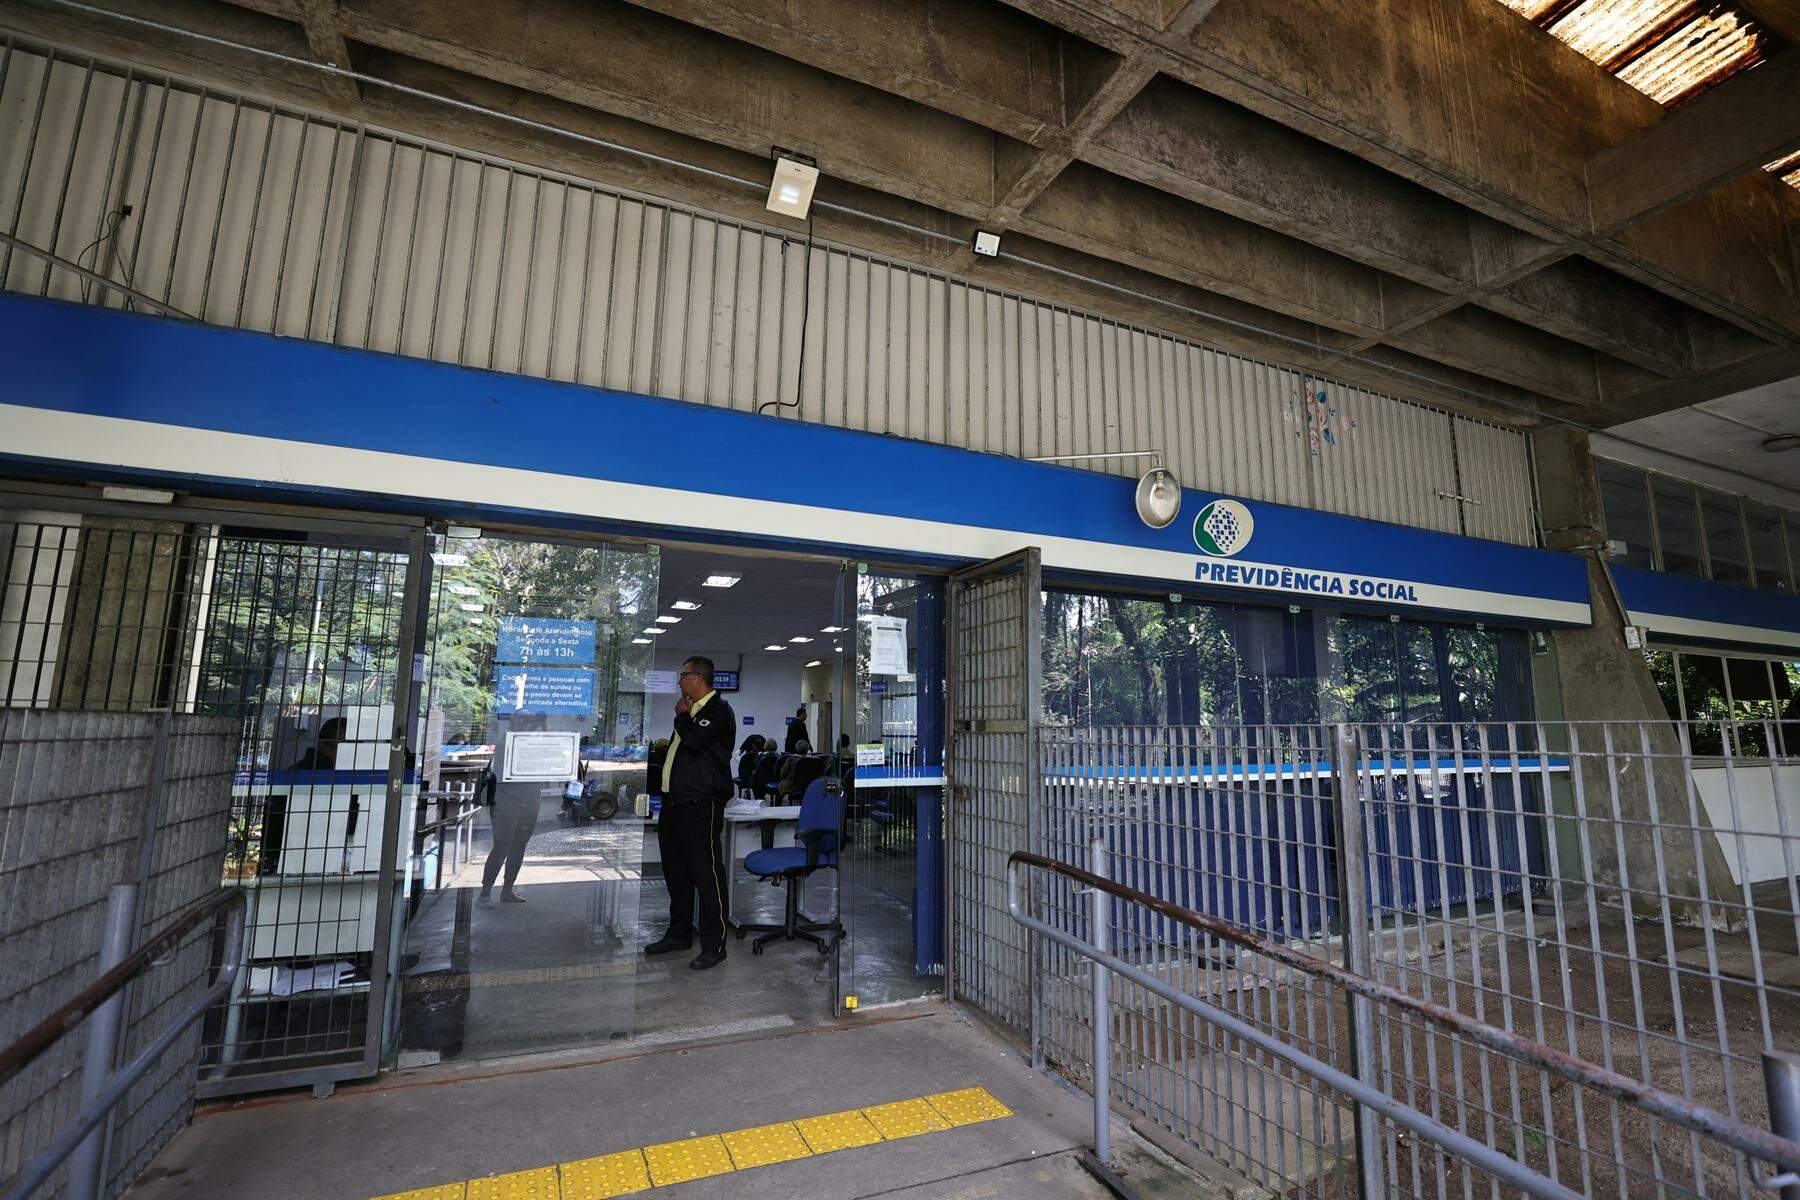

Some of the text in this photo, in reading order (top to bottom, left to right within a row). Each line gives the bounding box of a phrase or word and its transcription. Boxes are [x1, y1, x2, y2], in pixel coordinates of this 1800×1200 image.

[1195, 561, 1418, 602] PREVIDÊNCIA SOCIAL
[502, 625, 530, 634] Horár
[544, 627, 593, 637] Atendimento
[515, 636, 550, 645] Segunda
[558, 637, 579, 645] Sexta
[519, 646, 574, 657] 7h às 13h
[502, 674, 541, 682] Cadntes
[510, 683, 539, 691] apelho
[508, 691, 551, 699] maa-passo
[554, 699, 588, 707] alternativa
